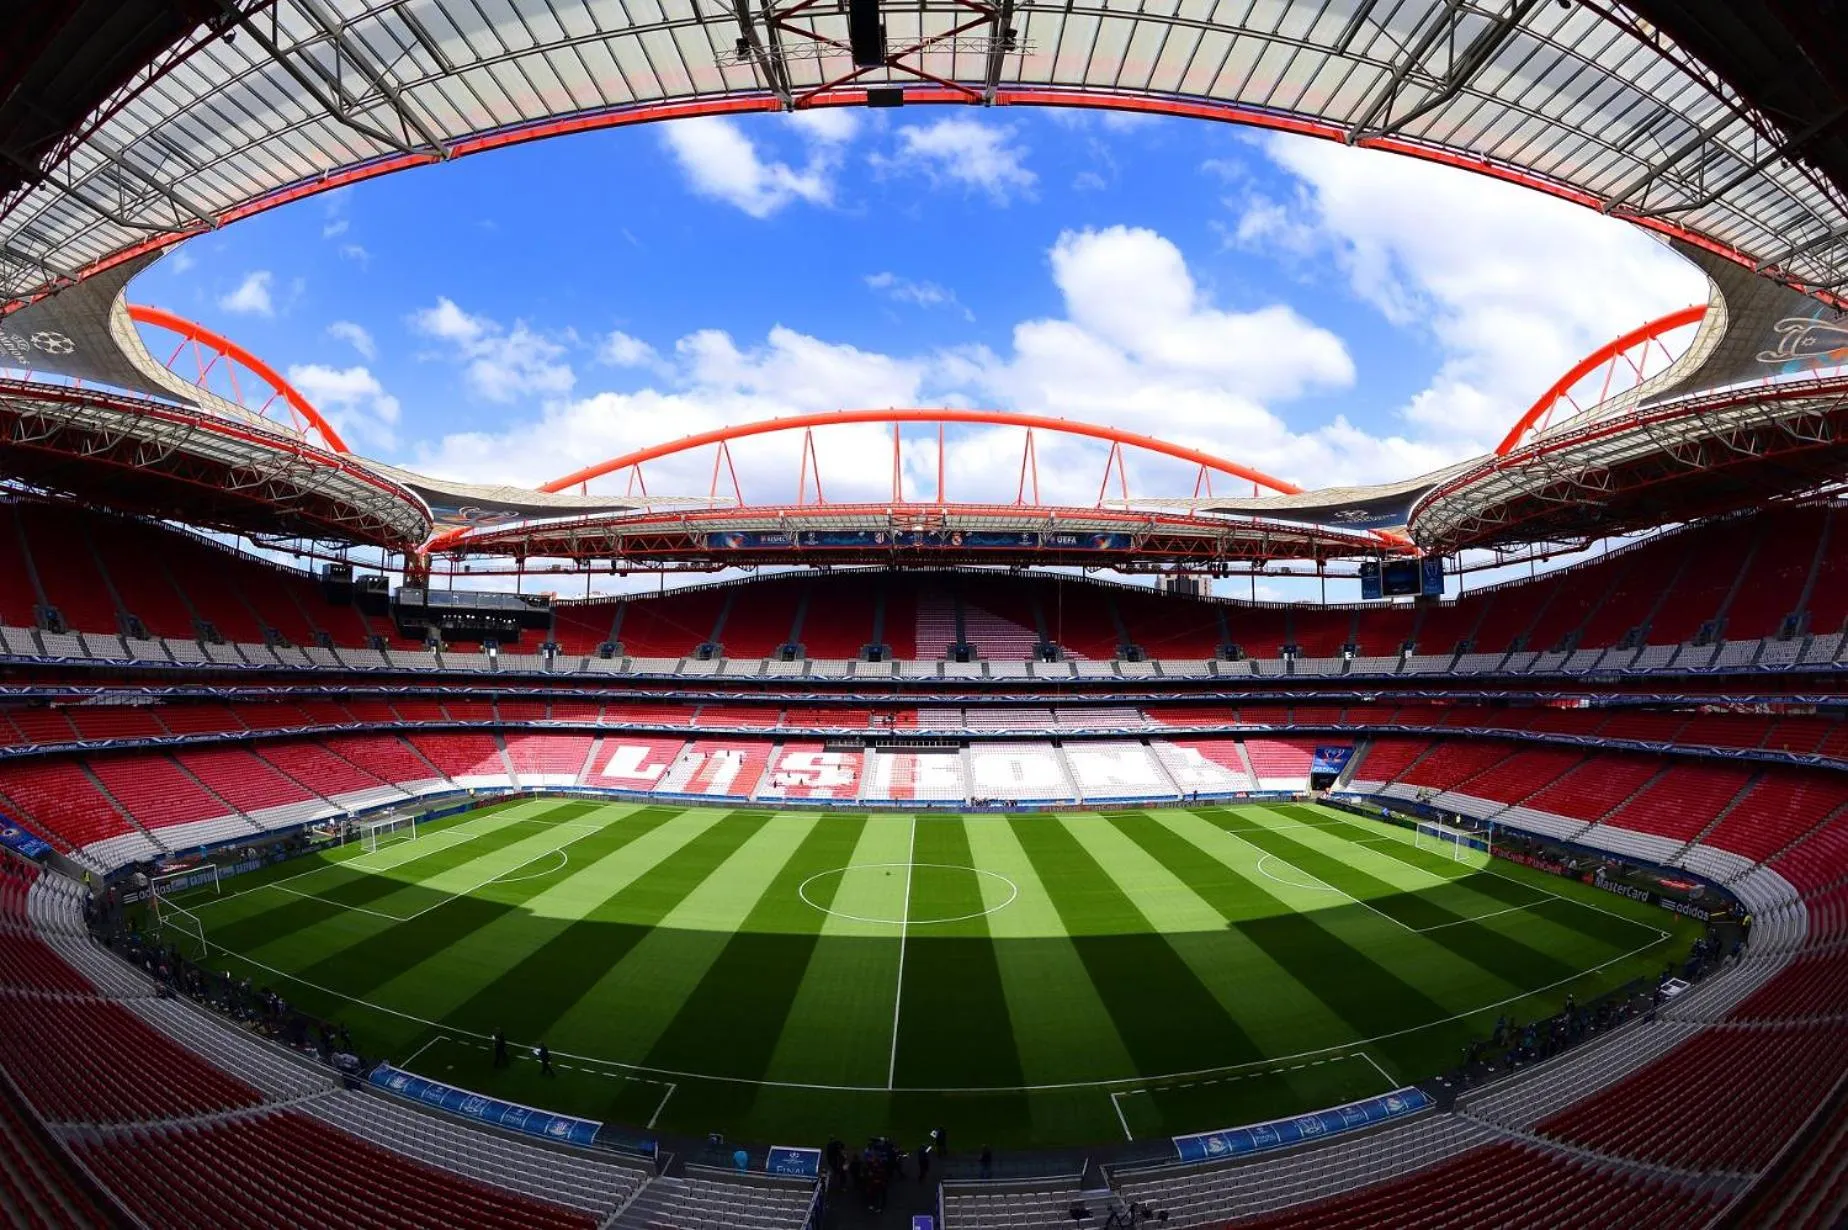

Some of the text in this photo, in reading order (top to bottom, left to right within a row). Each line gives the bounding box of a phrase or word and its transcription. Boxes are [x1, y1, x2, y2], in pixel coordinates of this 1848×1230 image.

[1056, 535, 1077, 544] UEFA
[1595, 877, 1650, 902] MasterCard
[1676, 902, 1710, 921] adidas
